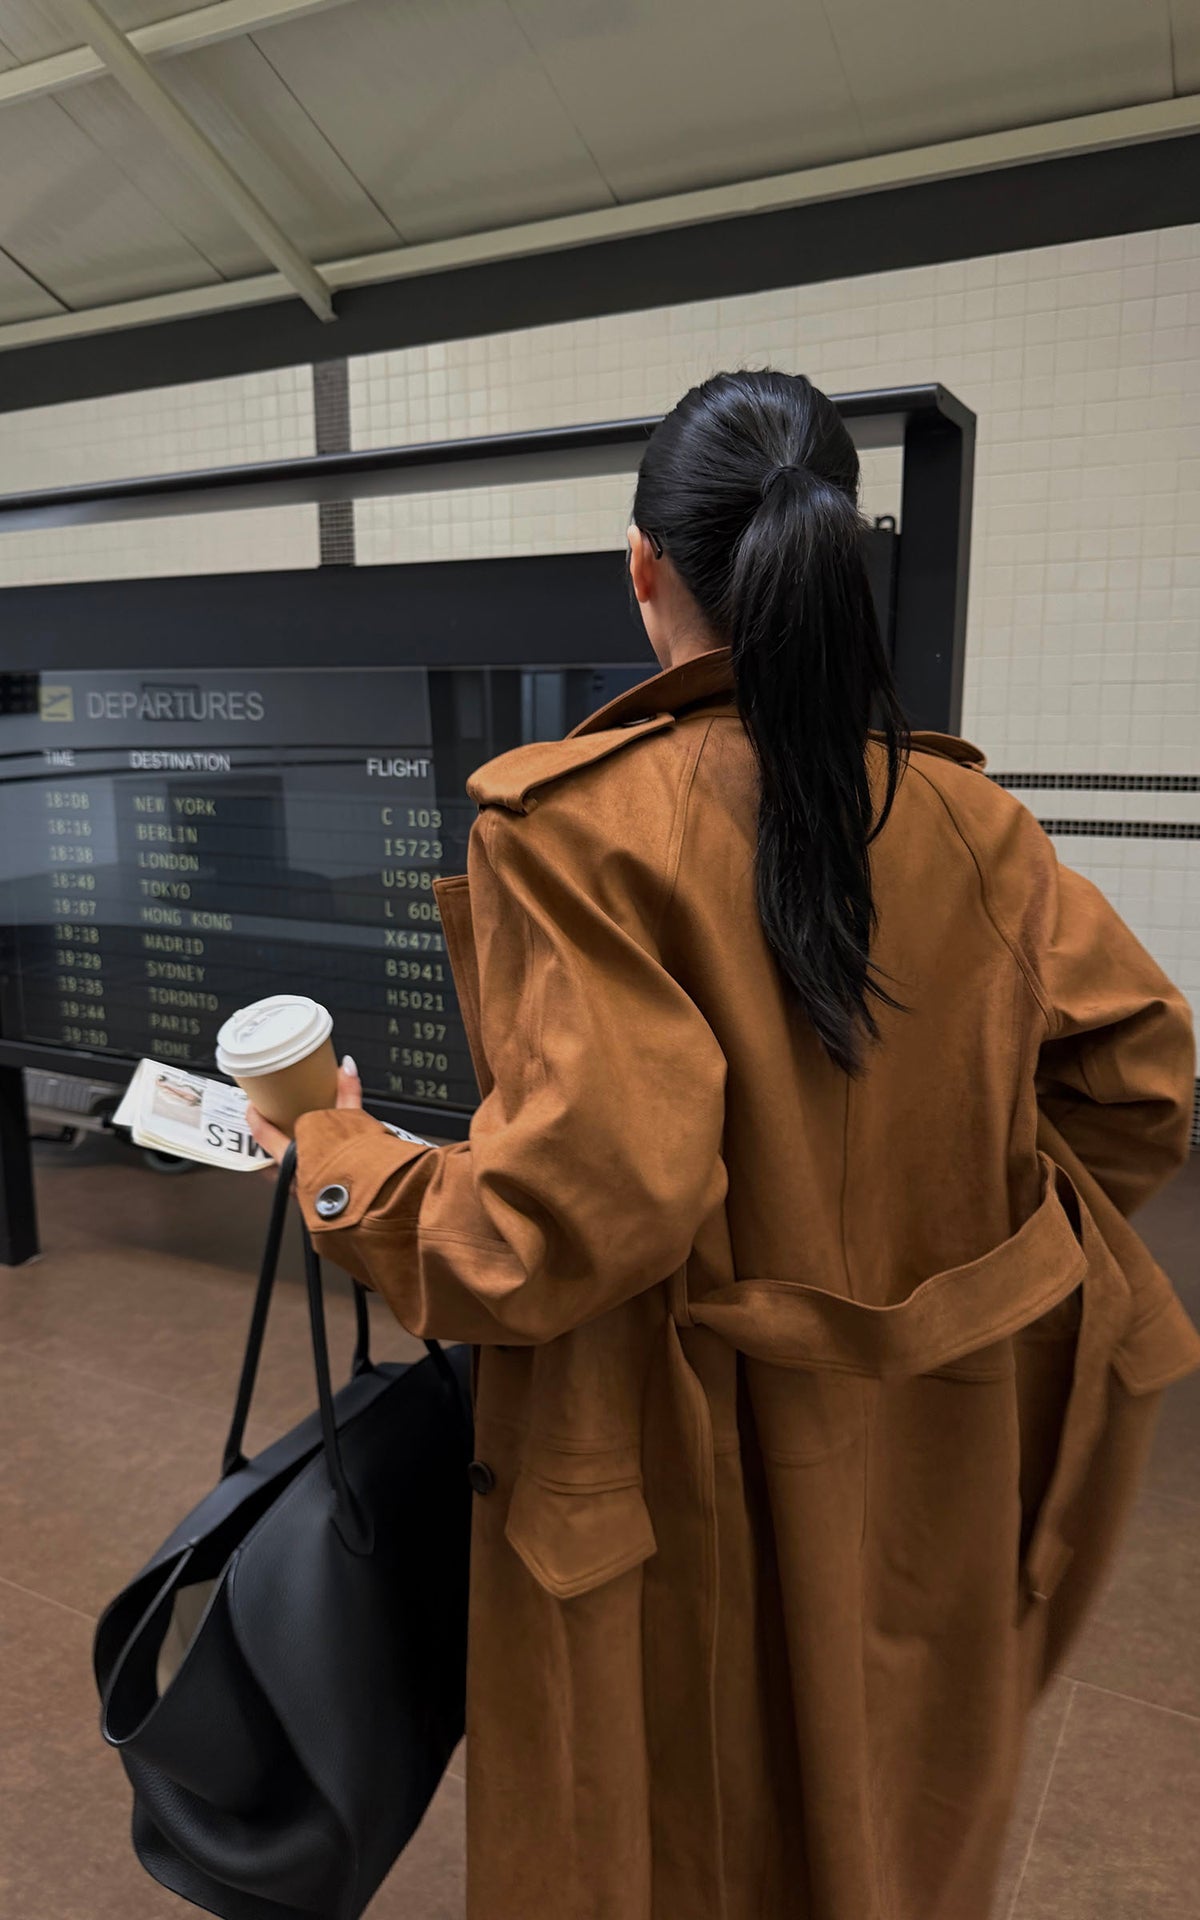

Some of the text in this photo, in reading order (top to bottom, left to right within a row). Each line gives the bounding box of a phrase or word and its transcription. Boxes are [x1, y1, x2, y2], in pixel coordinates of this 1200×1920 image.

[87, 691, 265, 721] DEPARTURES
[44, 749, 76, 768] TIME
[129, 751, 231, 771] DESTINATION
[366, 758, 430, 777] FLIGHT
[134, 796, 216, 816] NEW YORK
[381, 807, 443, 828] C 103
[136, 825, 198, 843] BERLIN
[139, 852, 199, 872] LONDON
[140, 879, 191, 900] TOKYO
[381, 870, 441, 890] U598
[142, 907, 233, 931] HONG KONG
[384, 900, 395, 918] L
[144, 933, 205, 956] MADRID
[384, 928, 443, 951] X6471
[146, 960, 205, 982] SYDNEY
[149, 986, 219, 1012] TORONTO
[386, 989, 444, 1012] H5021
[151, 1012, 200, 1036] PARIS
[388, 1018, 447, 1042] A 197
[152, 1038, 191, 1058] ROME
[390, 1048, 448, 1072] F5870
[415, 1079, 448, 1100] 324
